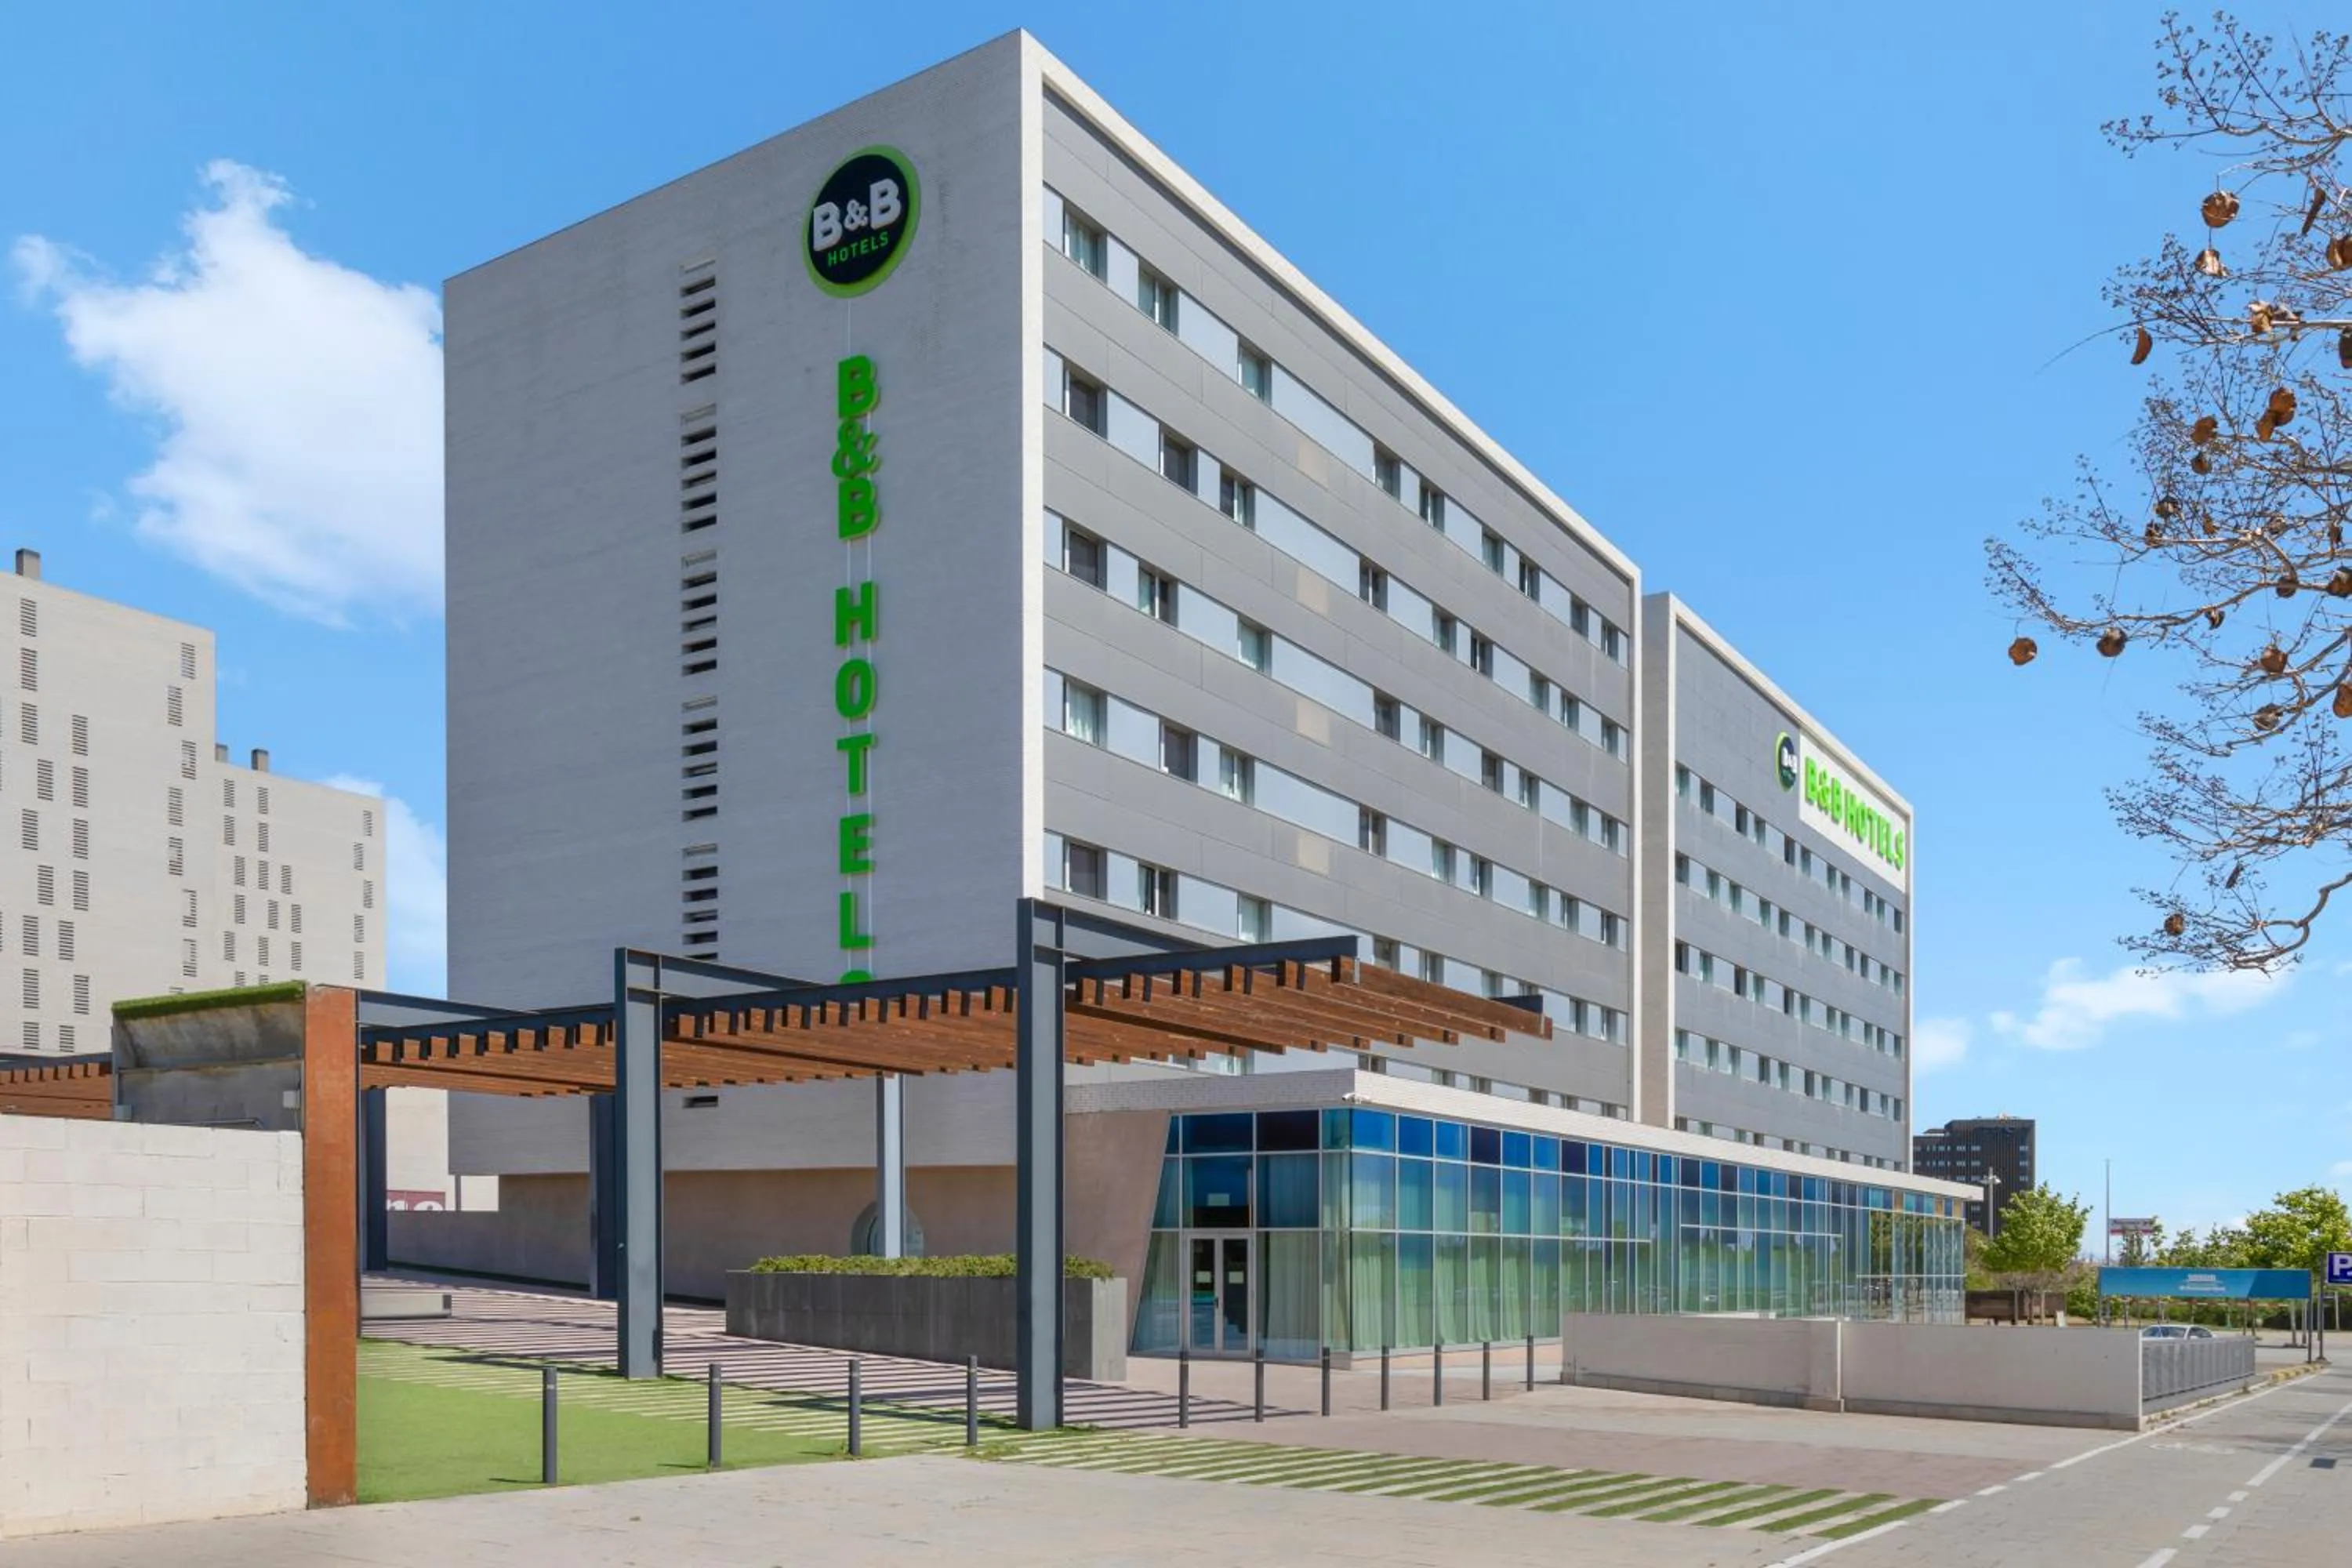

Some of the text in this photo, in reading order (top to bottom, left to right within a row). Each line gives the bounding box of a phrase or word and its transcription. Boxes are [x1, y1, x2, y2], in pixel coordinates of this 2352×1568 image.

[813, 178, 902, 252] B&B
[827, 231, 889, 267] HOTELS
[831, 354, 880, 985] B&B HOTEL
[1805, 756, 1904, 872] B&B HOTELS
